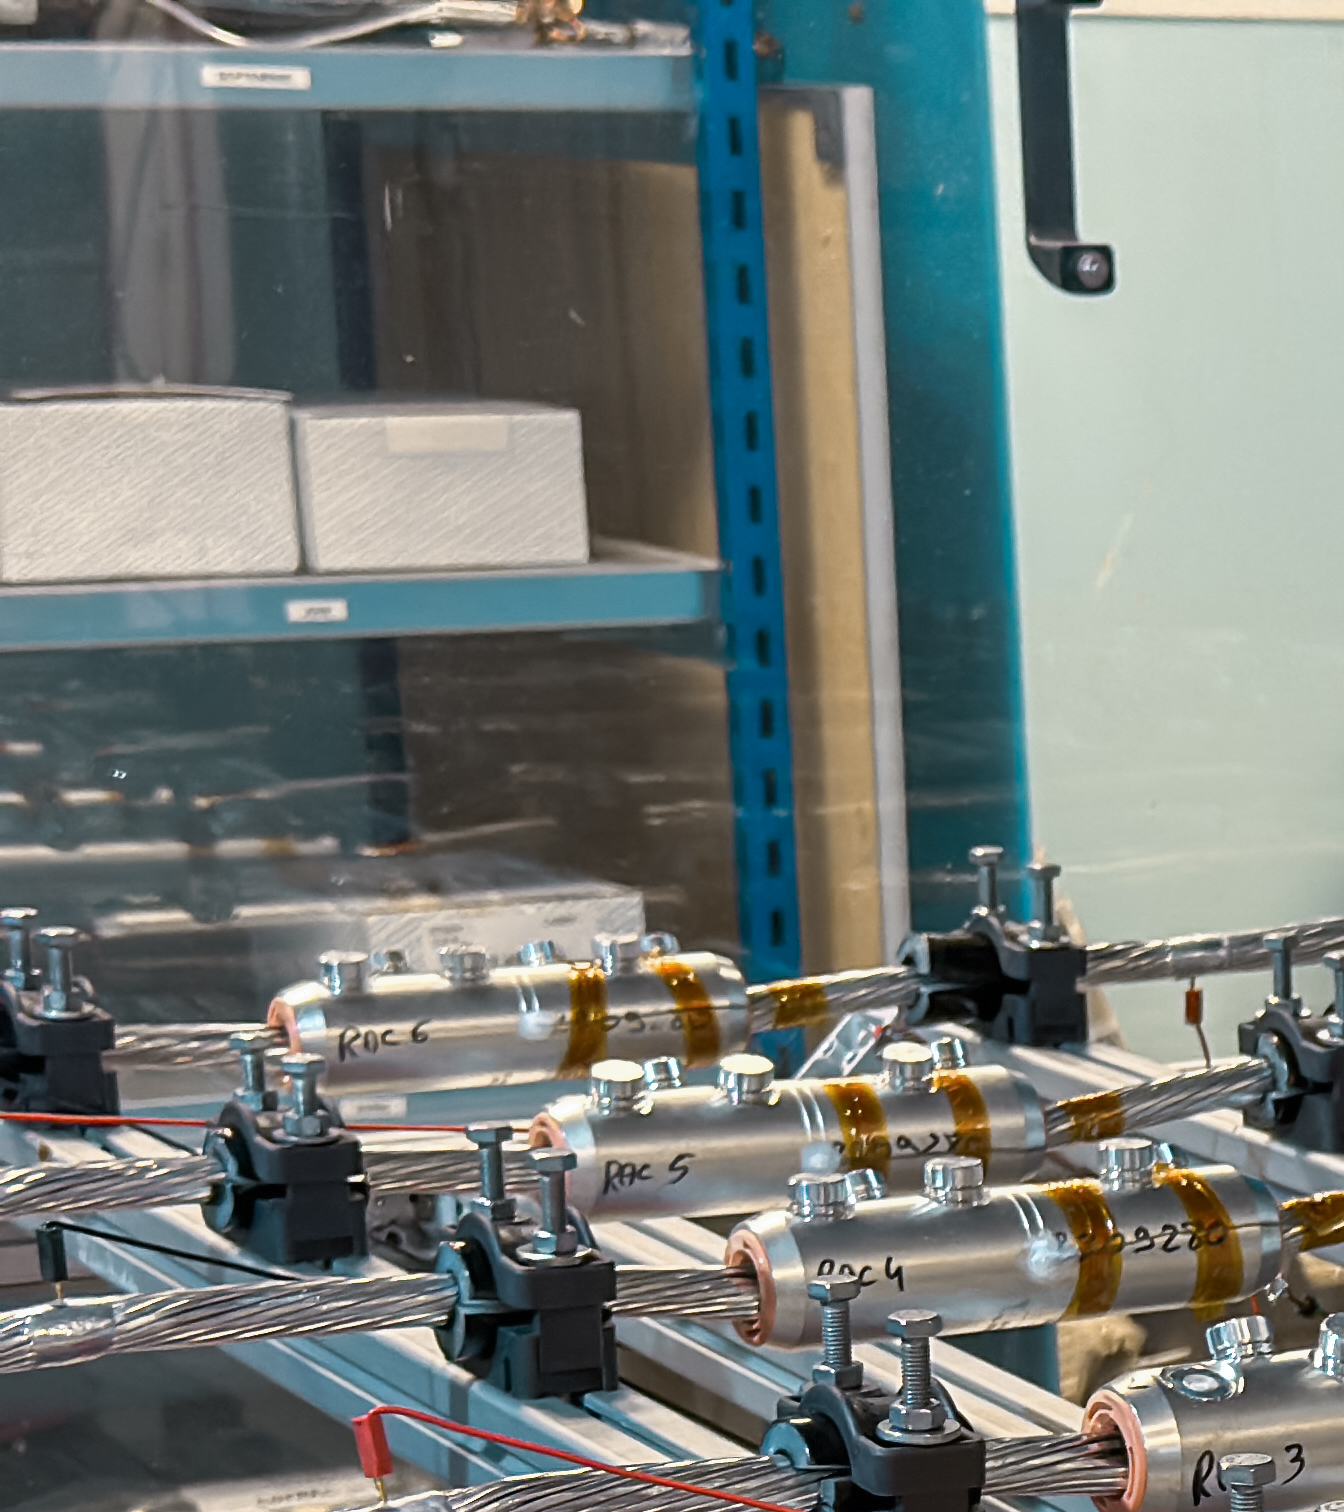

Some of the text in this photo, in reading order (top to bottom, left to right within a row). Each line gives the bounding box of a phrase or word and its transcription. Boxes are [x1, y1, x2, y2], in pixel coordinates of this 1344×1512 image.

[411, 1018, 432, 1044] 6
[666, 1152, 696, 1185] 5
[884, 1256, 904, 1292] 4
[1280, 1443, 1306, 1486] 3
